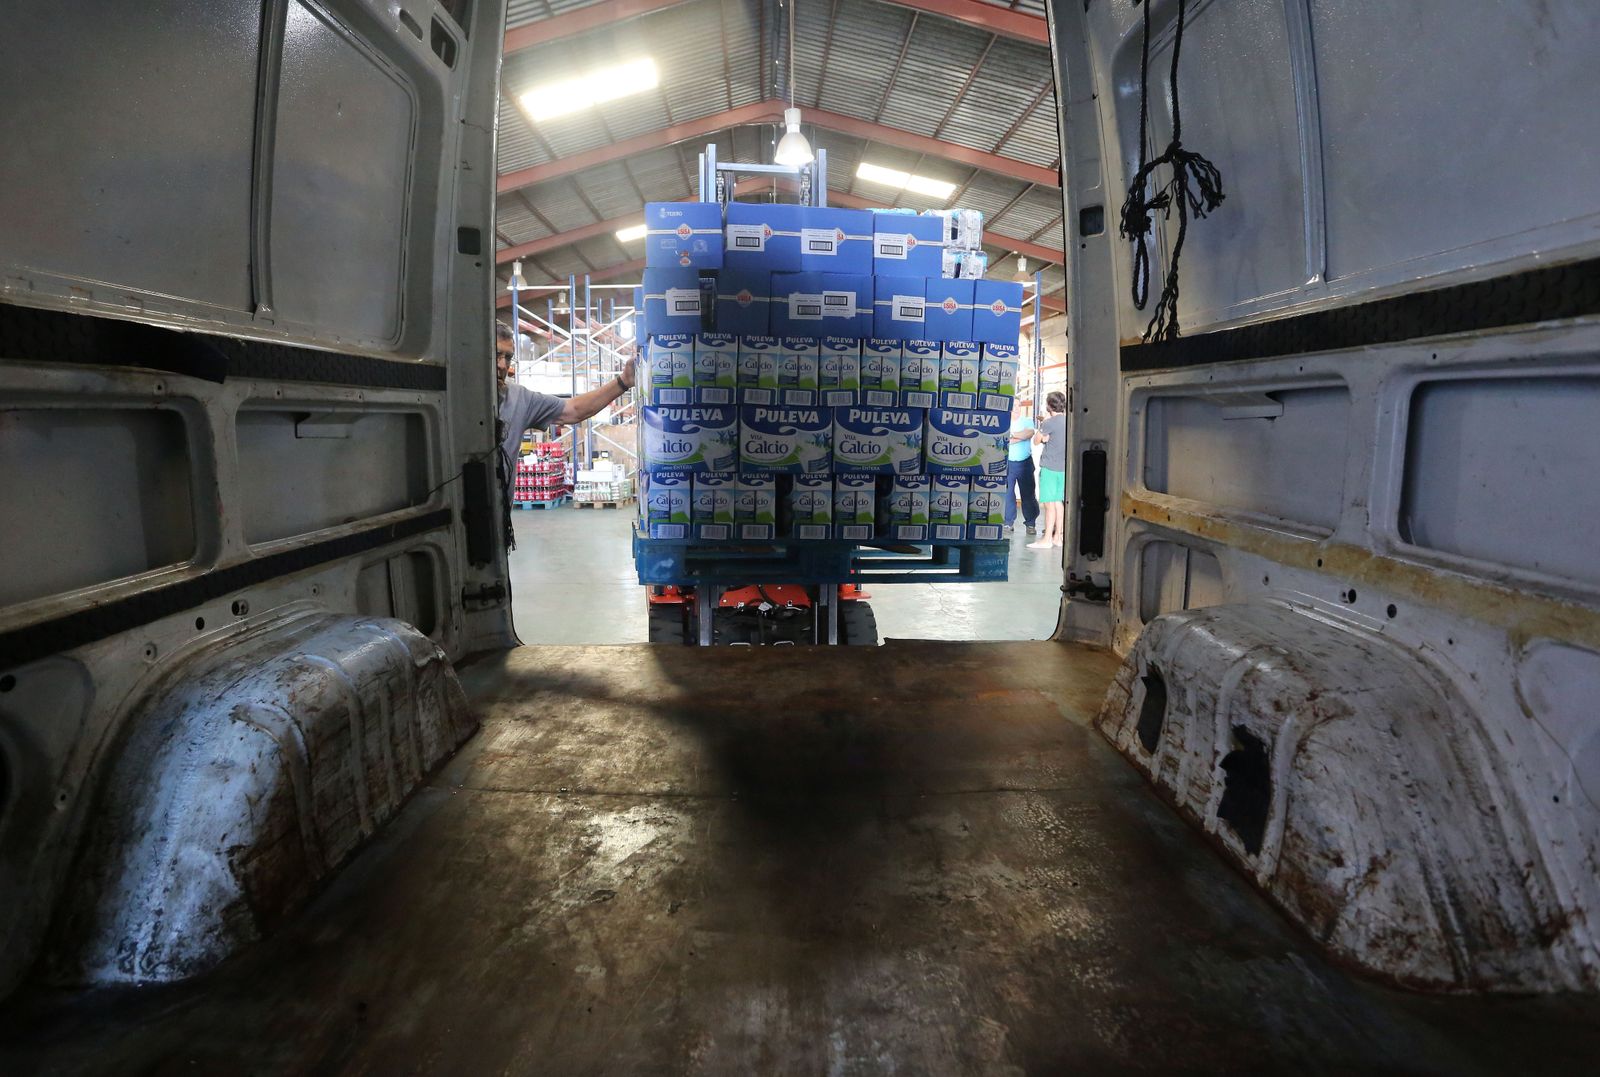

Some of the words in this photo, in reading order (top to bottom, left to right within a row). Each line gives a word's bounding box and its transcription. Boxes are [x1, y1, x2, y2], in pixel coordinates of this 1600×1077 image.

[826, 336, 854, 344] PULEVA
[949, 340, 975, 349] PULEVA
[990, 343, 1015, 351] PULEVA
[657, 408, 724, 420] PULEVA
[754, 408, 820, 424] PULEVA
[848, 408, 911, 424] PULEVA
[941, 410, 1000, 428] PULEVA
[745, 440, 788, 454] Calcio
[840, 440, 882, 455] Calcio
[932, 442, 972, 456] Calcio
